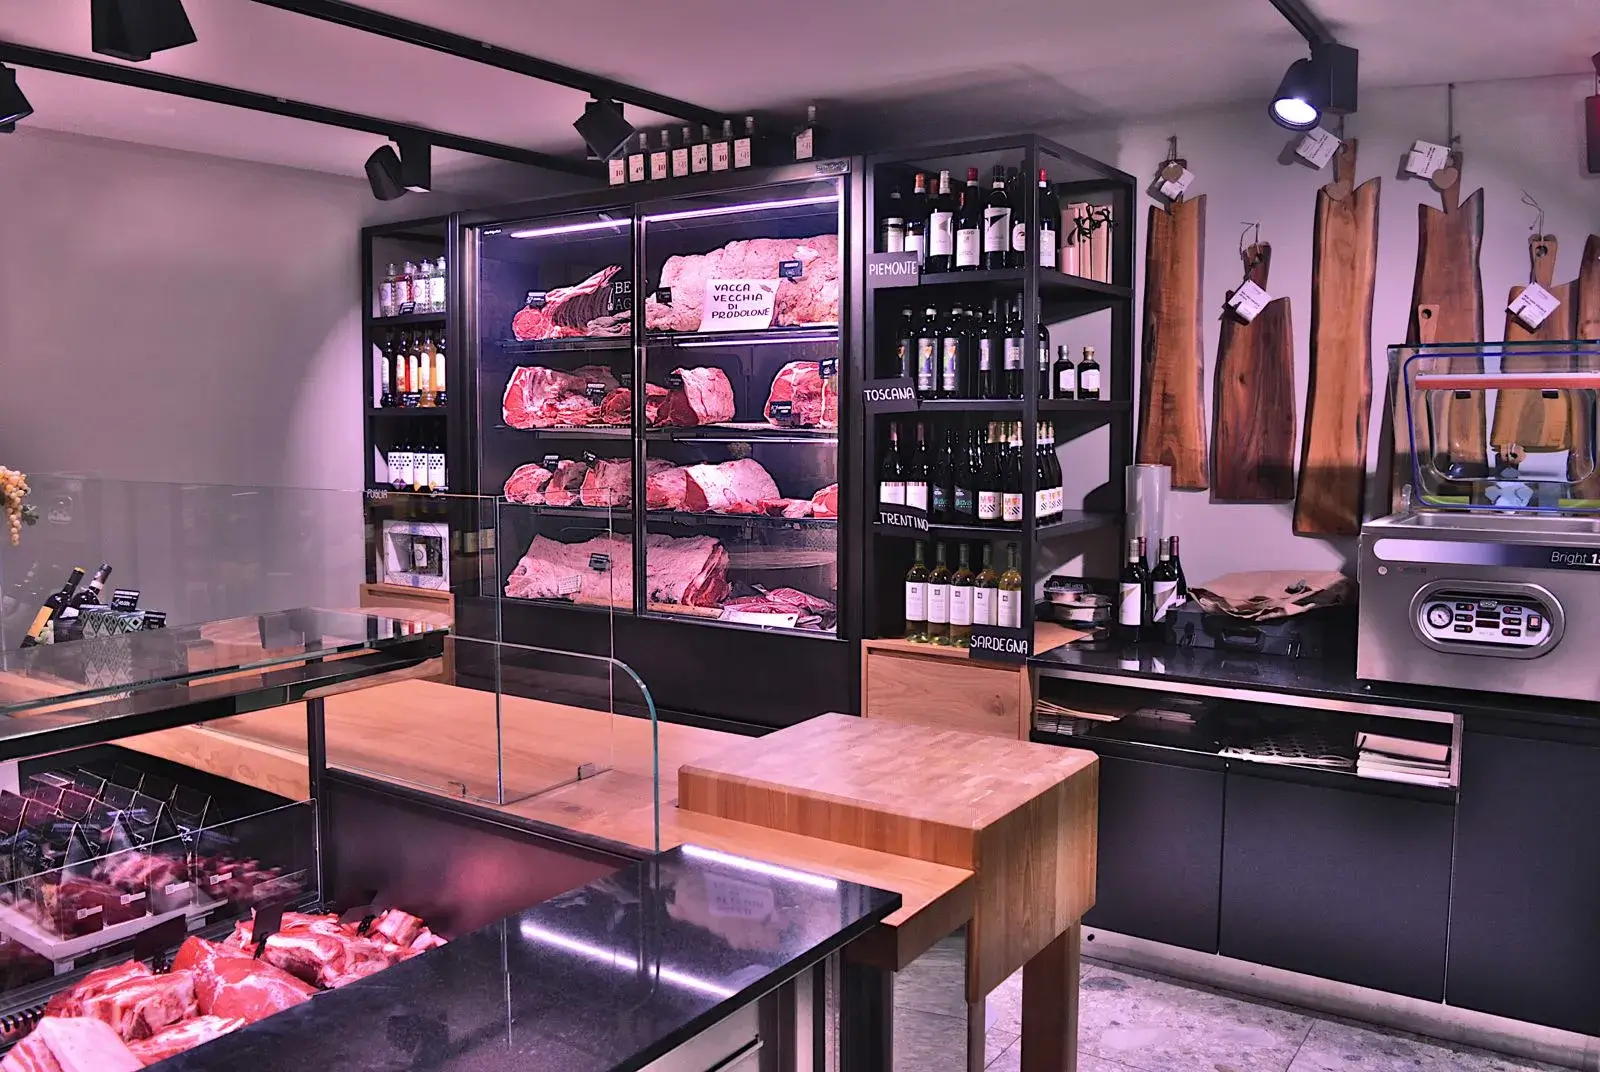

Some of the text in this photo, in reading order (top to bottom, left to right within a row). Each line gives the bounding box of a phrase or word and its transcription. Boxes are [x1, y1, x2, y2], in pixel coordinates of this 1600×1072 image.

[868, 260, 918, 276] PIEMONTE
[714, 283, 751, 292] VACCA
[713, 293, 763, 302] VECCHIA
[711, 308, 770, 319] PRODOLONE
[864, 387, 915, 401] TOSCANA
[366, 488, 388, 499] PUGLIA
[879, 511, 929, 532] TRENTINO
[1551, 551, 1600, 566] Bright 1
[970, 635, 1029, 655] SARDEGNA
